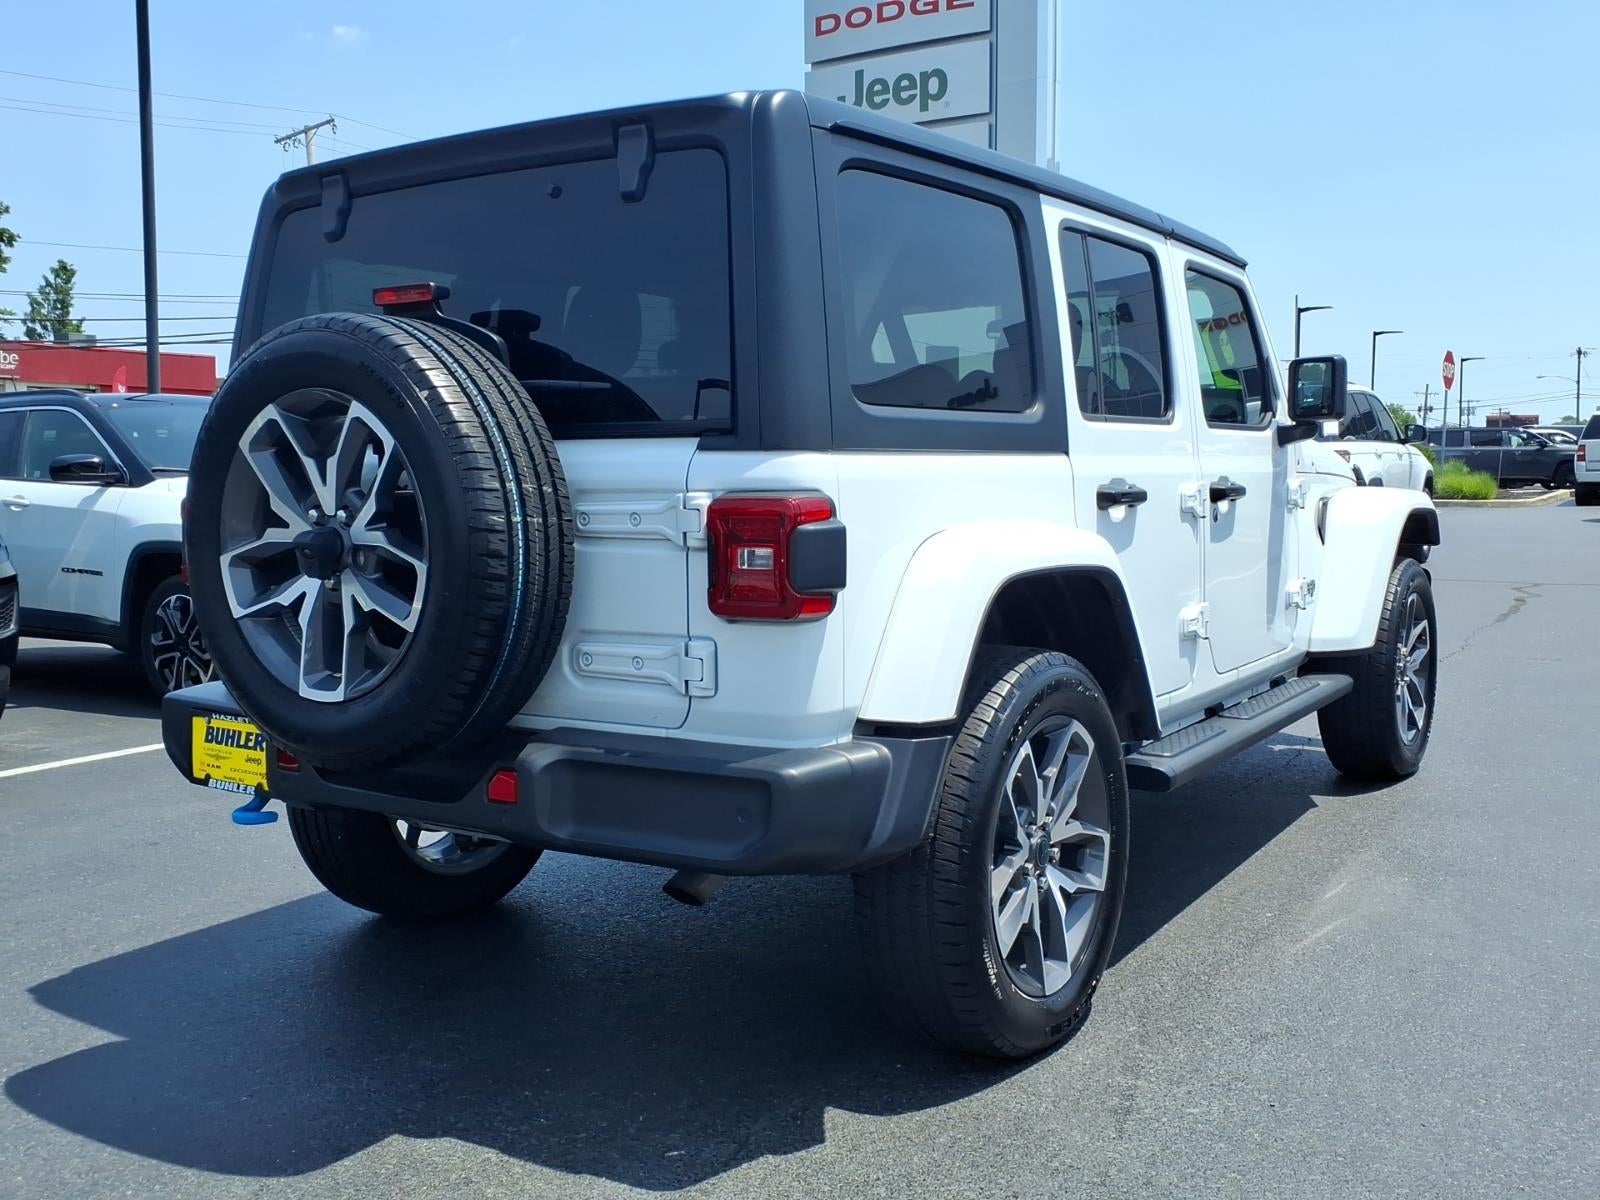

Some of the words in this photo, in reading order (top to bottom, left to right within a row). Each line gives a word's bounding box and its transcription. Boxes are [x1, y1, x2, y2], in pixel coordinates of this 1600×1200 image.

[837, 68, 948, 112] Jeep
[1442, 361, 1455, 379] STOP
[212, 713, 249, 723] HAZLET
[204, 725, 266, 752] BUHLER
[244, 755, 262, 766] Jeep
[208, 778, 256, 795] BUHLER
